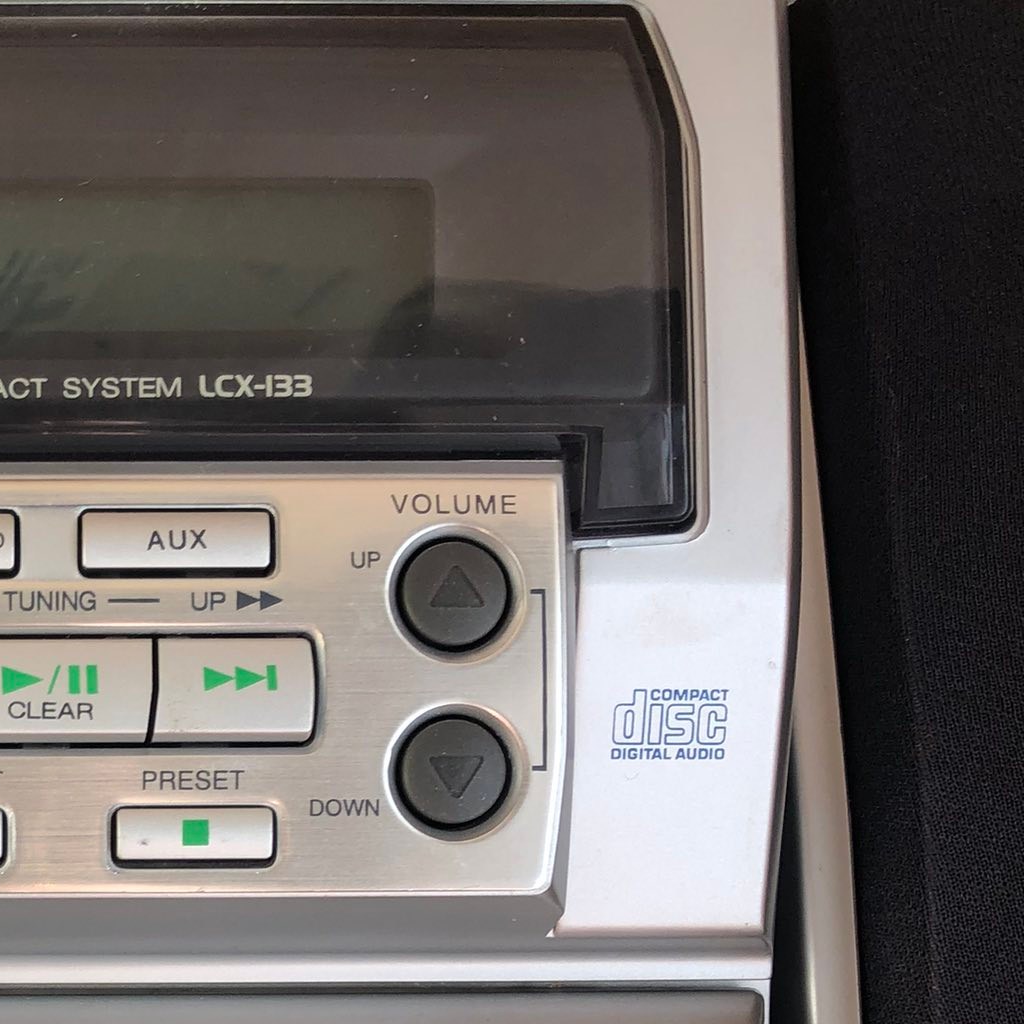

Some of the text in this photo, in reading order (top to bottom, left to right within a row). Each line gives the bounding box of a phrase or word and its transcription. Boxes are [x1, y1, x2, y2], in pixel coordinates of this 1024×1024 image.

[62, 376, 182, 399] SYSTEM
[199, 374, 313, 398] LCX-133
[391, 493, 517, 515] VOLUME
[147, 529, 207, 551] AUX
[350, 551, 381, 569] UP
[2, 590, 97, 612] TUNING
[191, 591, 226, 612] UP
[650, 688, 729, 701] COMPACT
[7, 701, 93, 721] CLEAR
[610, 747, 726, 761] DIGITAL AUDIO
[142, 769, 245, 791] PRESET
[309, 798, 380, 817] DOWN
